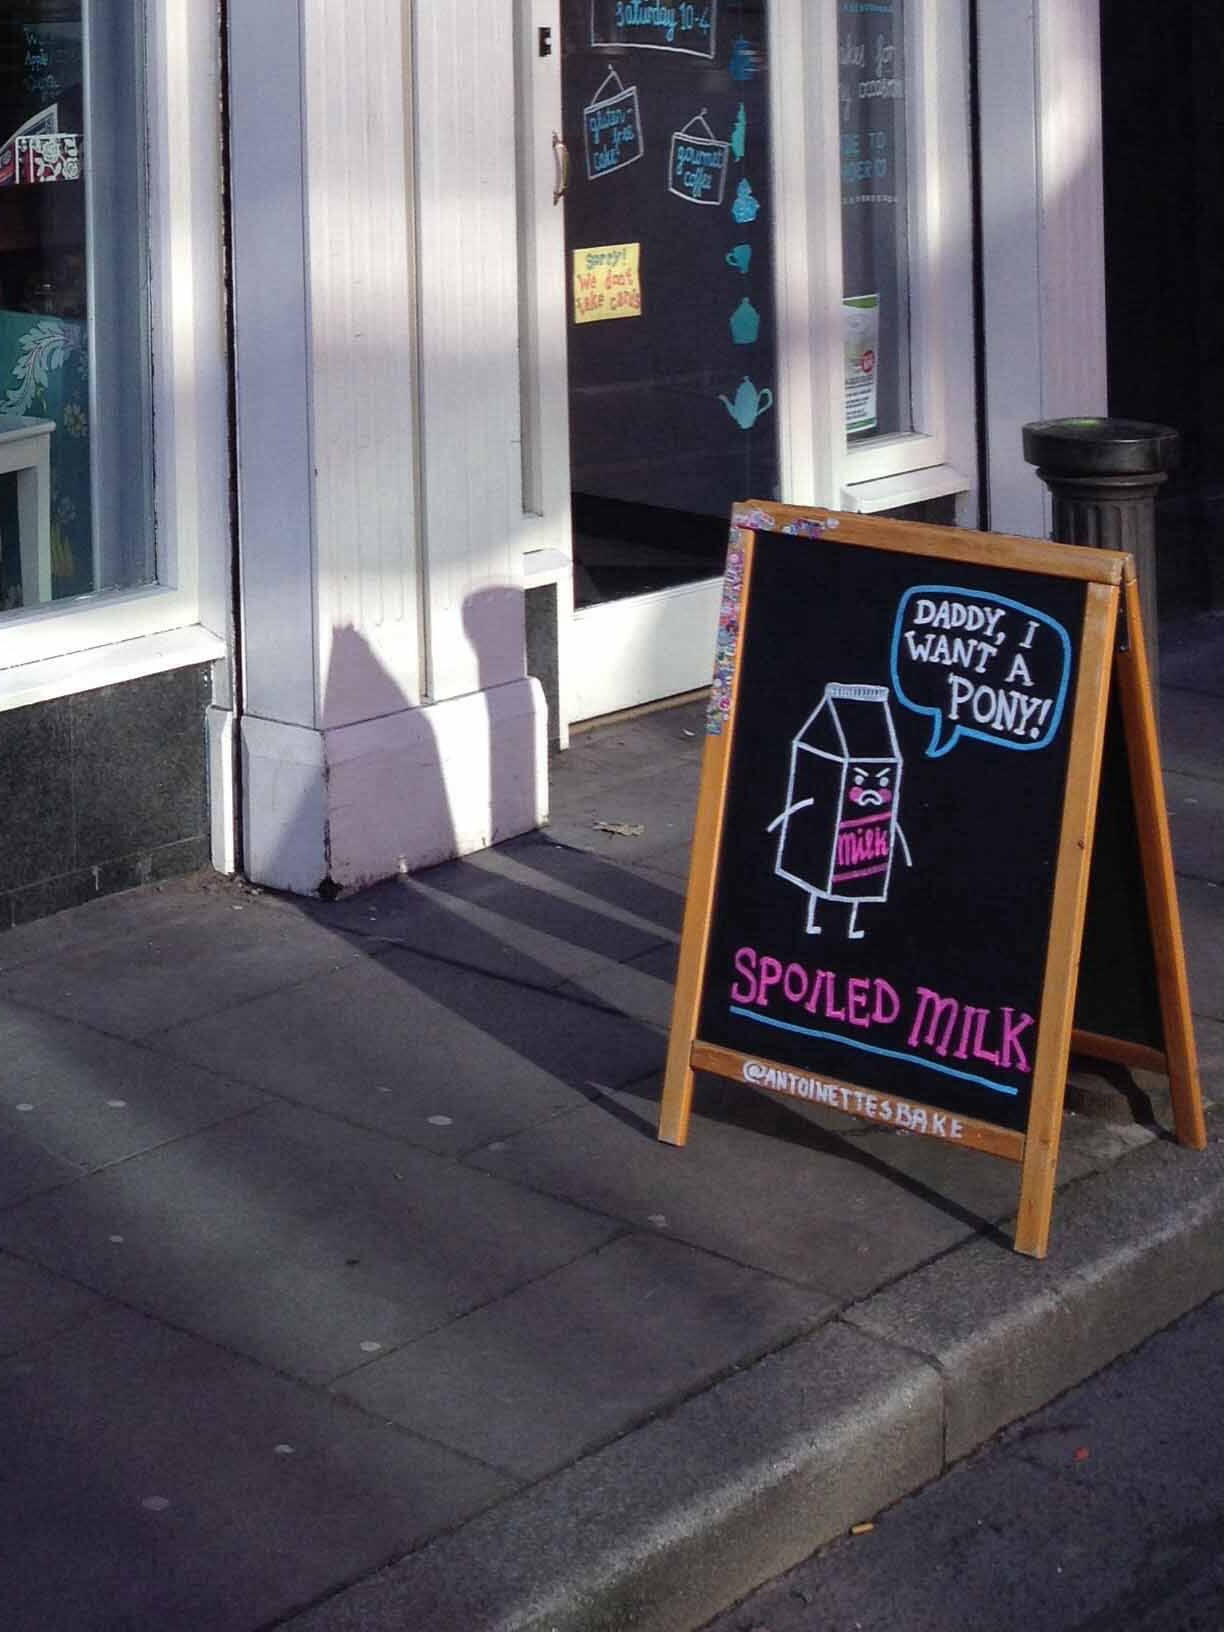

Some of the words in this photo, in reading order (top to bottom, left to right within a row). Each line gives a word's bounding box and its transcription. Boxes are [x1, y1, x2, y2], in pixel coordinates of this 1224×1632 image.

[913, 599, 1006, 645] DADDY,
[1019, 620, 1041, 649] I
[903, 629, 998, 674] WANT
[1004, 653, 1035, 687] A
[948, 671, 1053, 740] PONY!
[730, 946, 901, 1029] SPOILED
[907, 985, 1035, 1073] MILK
